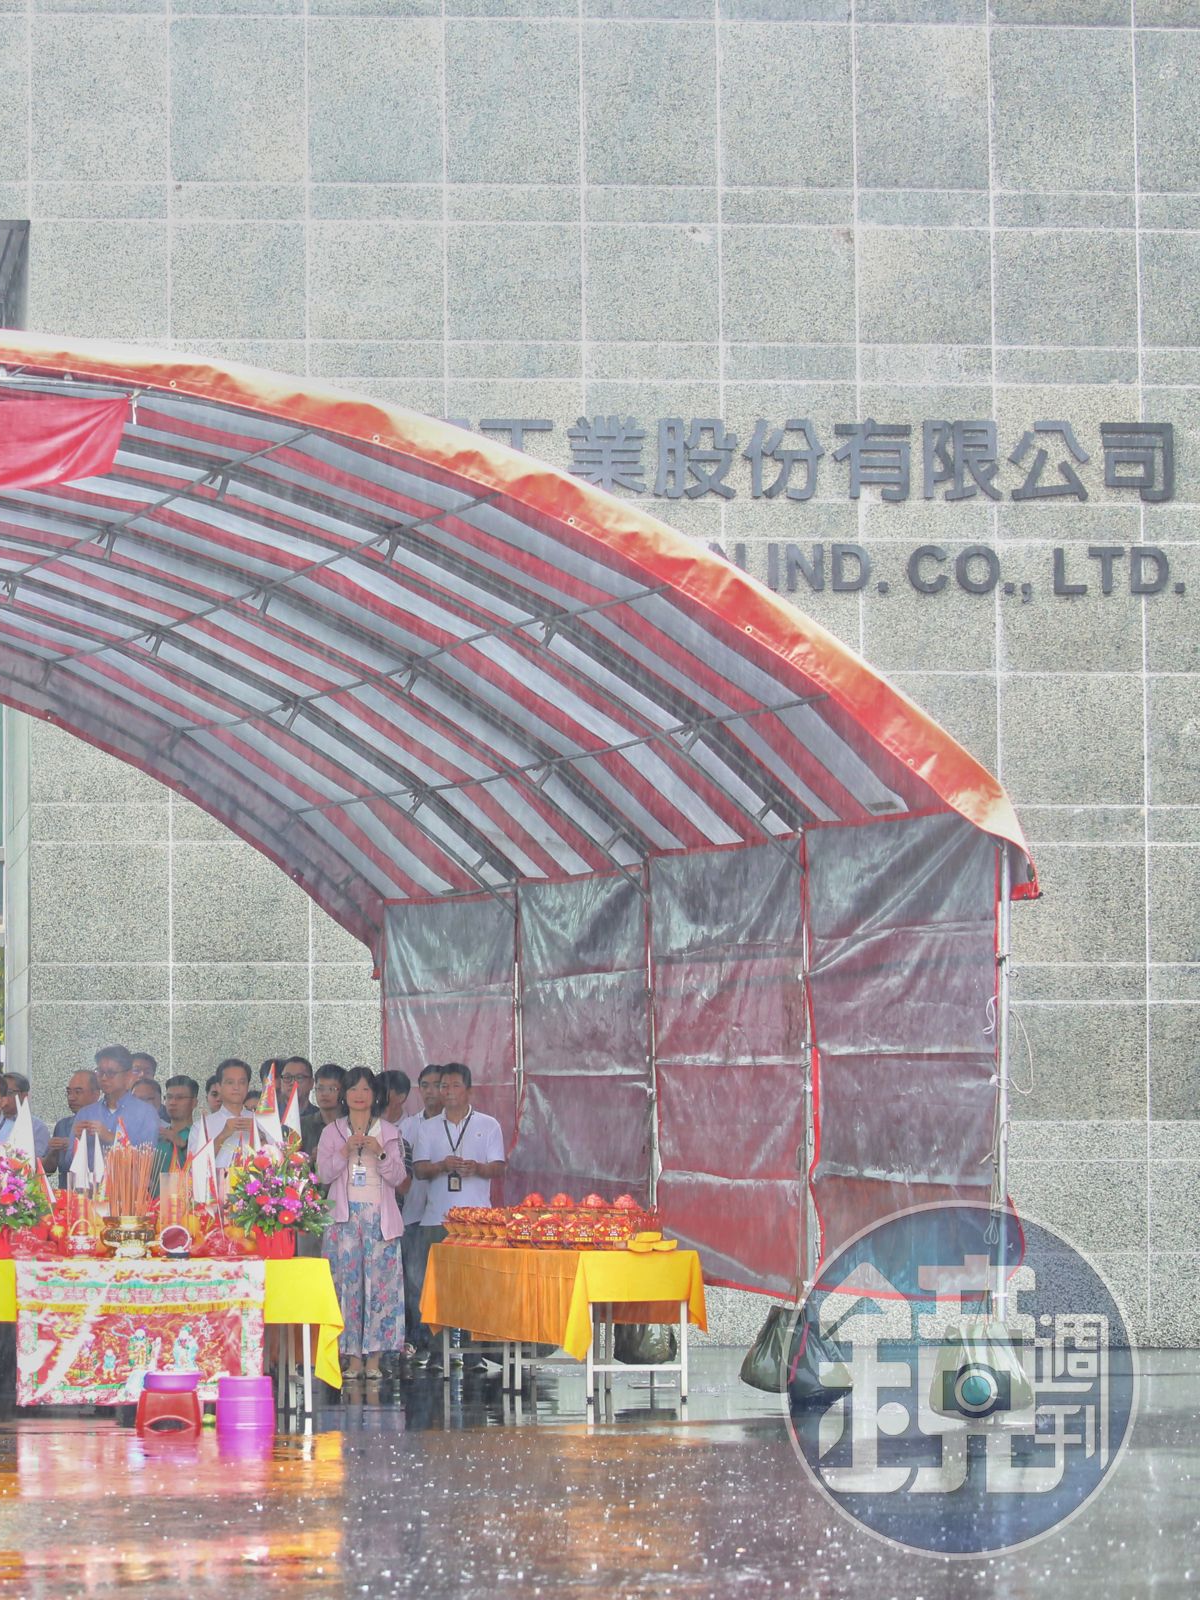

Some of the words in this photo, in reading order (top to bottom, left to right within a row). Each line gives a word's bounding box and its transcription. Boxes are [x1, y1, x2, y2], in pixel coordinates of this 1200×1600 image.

[442, 415, 1175, 501] 業股份有限公司
[767, 543, 890, 593] IND.
[907, 544, 1032, 603] CO.,
[1053, 546, 1186, 595] LTD.
